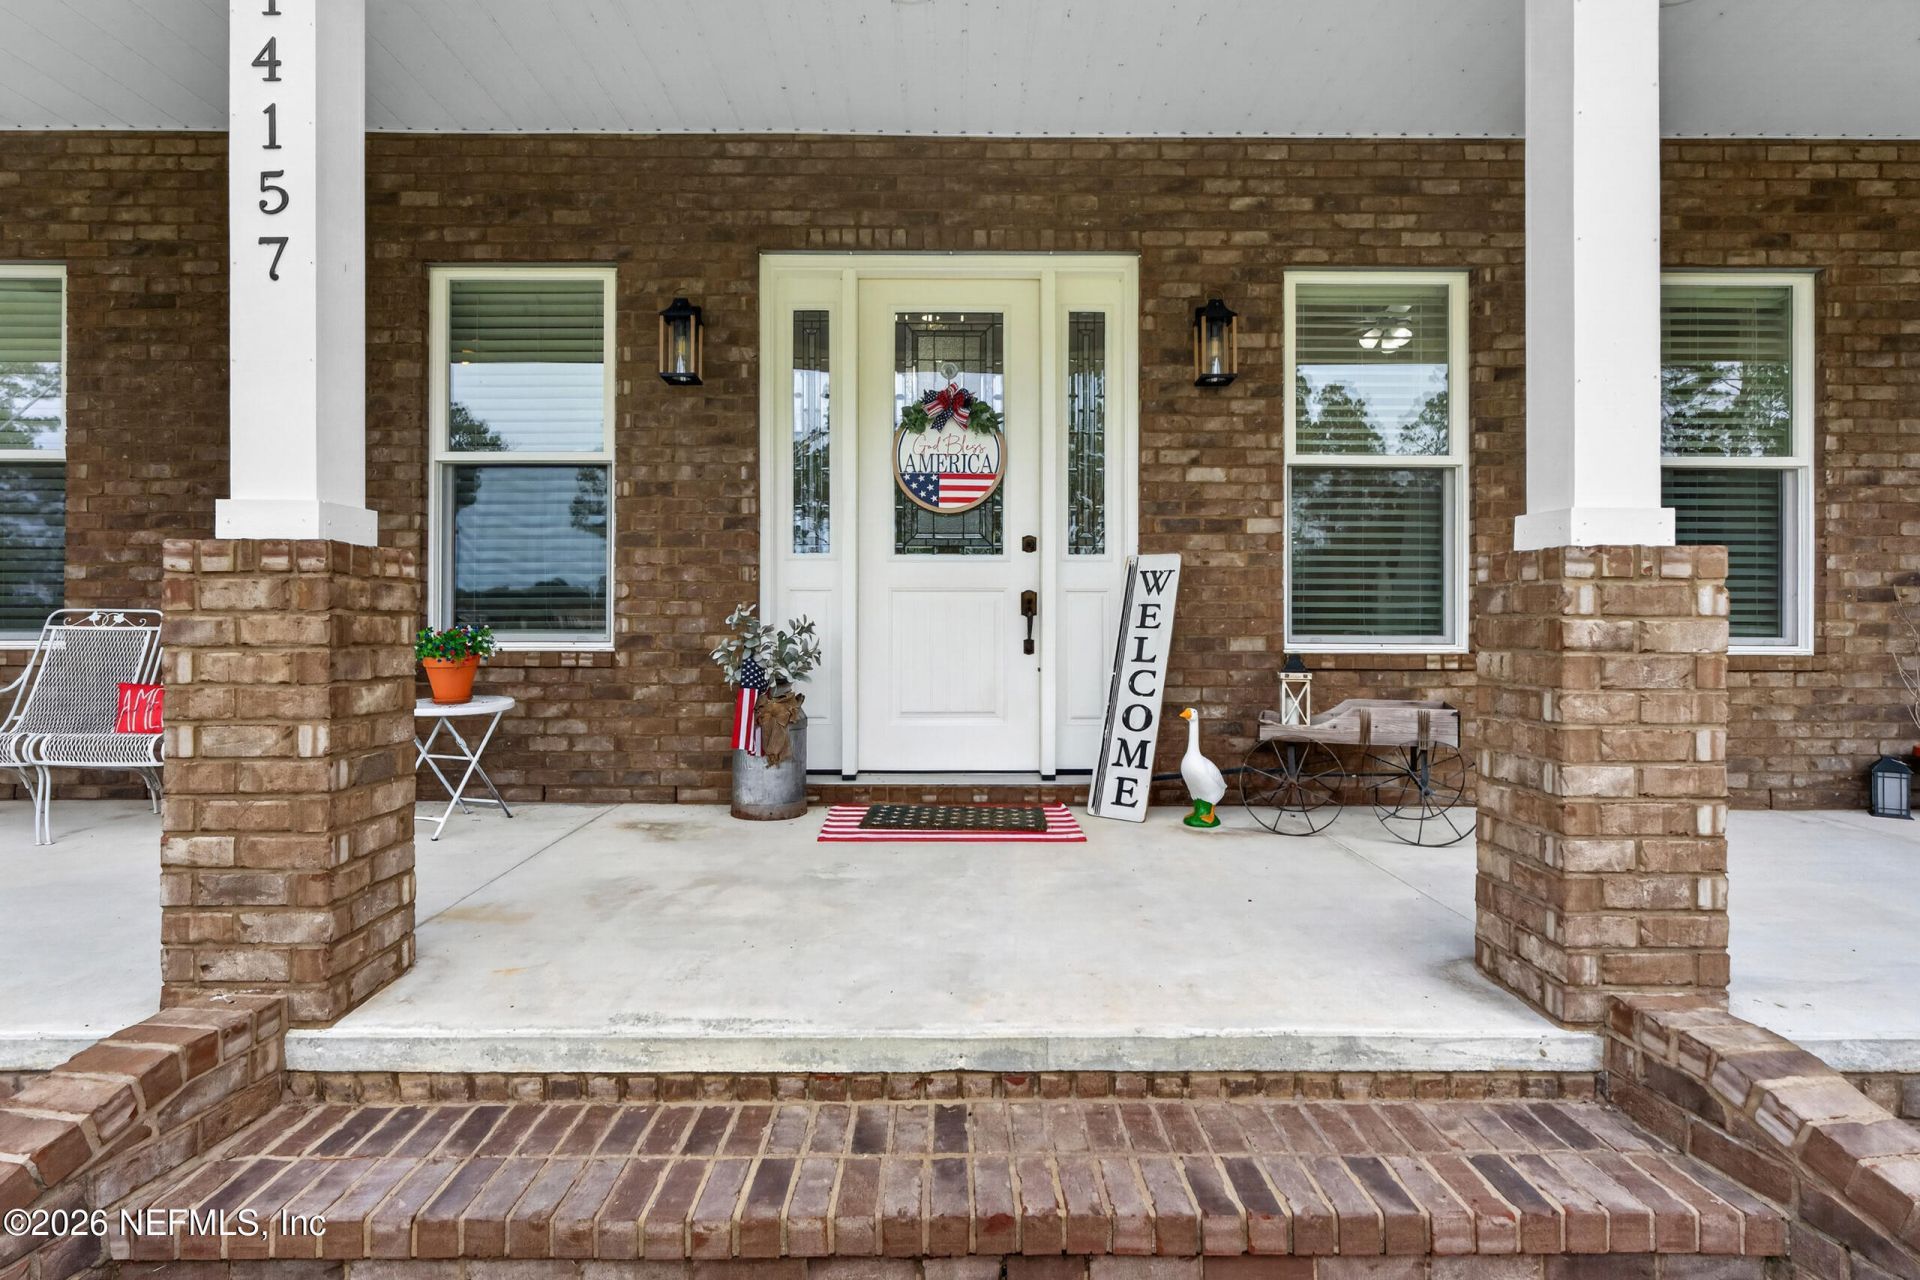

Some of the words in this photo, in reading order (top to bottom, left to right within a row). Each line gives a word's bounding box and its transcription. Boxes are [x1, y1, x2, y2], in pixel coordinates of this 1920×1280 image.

[912, 433, 941, 455] God
[942, 433, 987, 457] Bless
[903, 453, 994, 474] AMERICA
[1110, 569, 1176, 809] WELCOME
